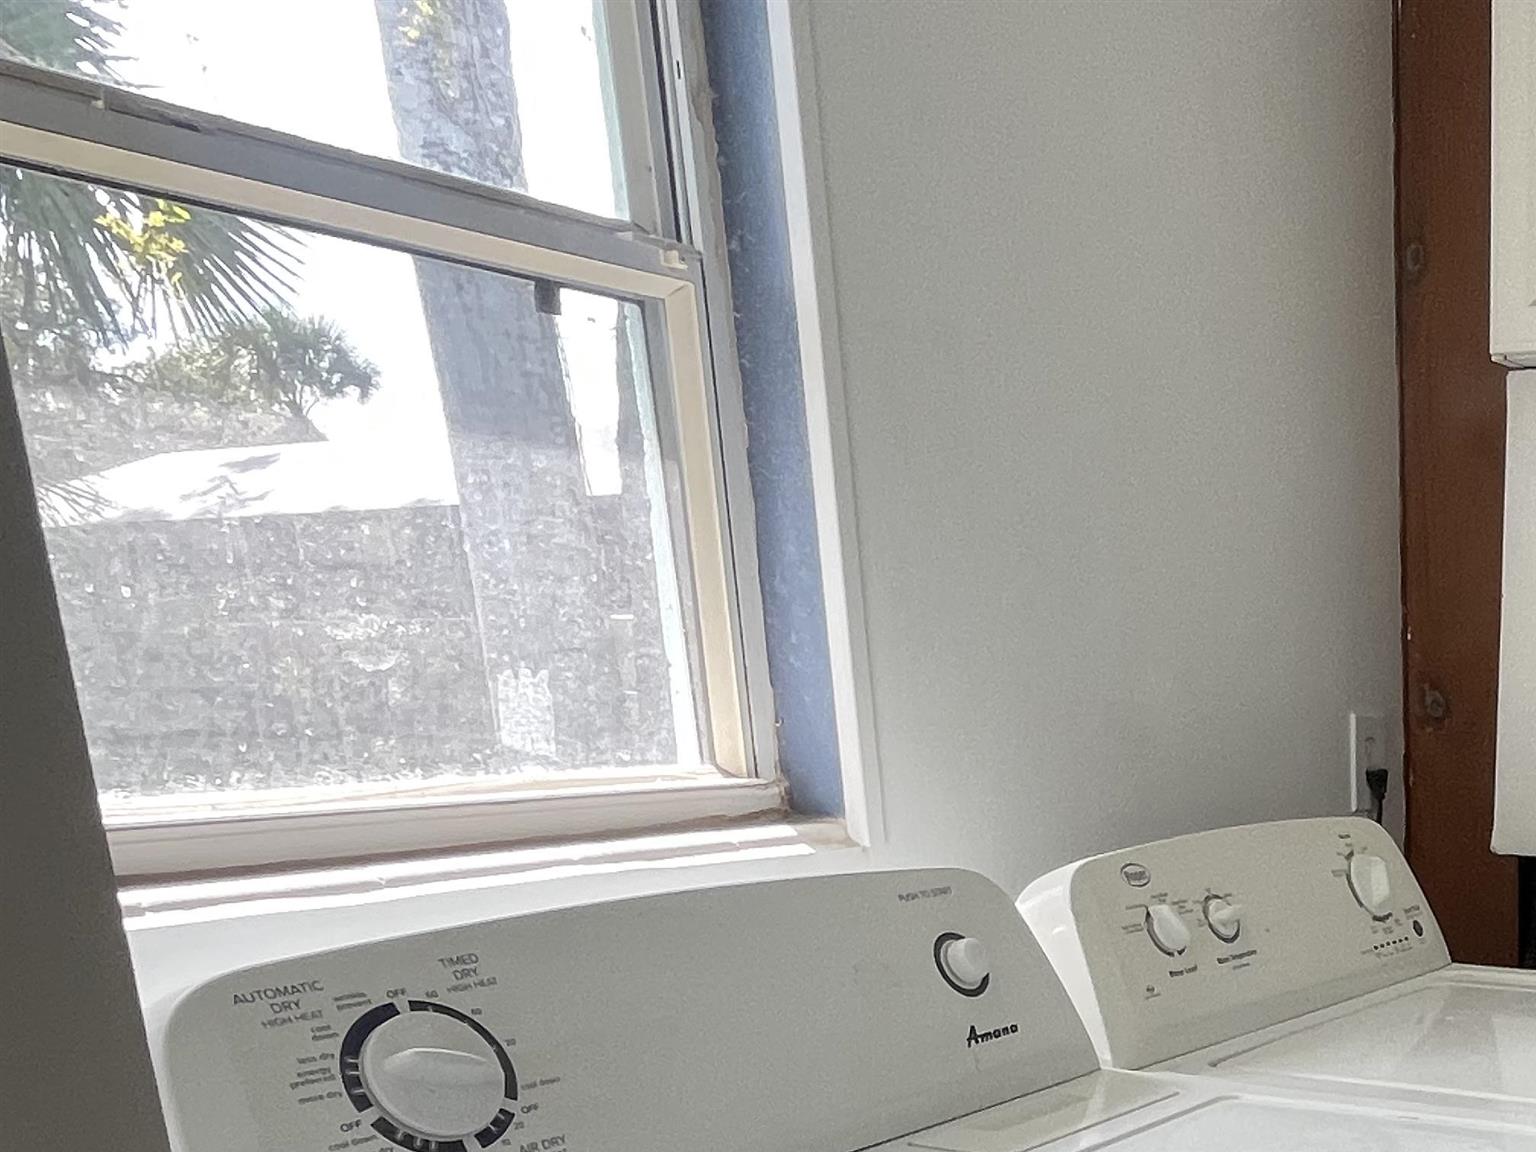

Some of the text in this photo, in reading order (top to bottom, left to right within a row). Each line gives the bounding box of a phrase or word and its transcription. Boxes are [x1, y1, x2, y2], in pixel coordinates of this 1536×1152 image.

[437, 952, 480, 968] TIMED
[452, 967, 479, 981] DRY
[233, 980, 325, 1005] AUTOMATIC
[386, 988, 407, 1000] OFF
[269, 999, 302, 1014] DRY
[966, 1023, 1019, 1048] Amana
[520, 1103, 539, 1114] OFF
[340, 1119, 363, 1132] OFF
[541, 1134, 565, 1150] DRY
